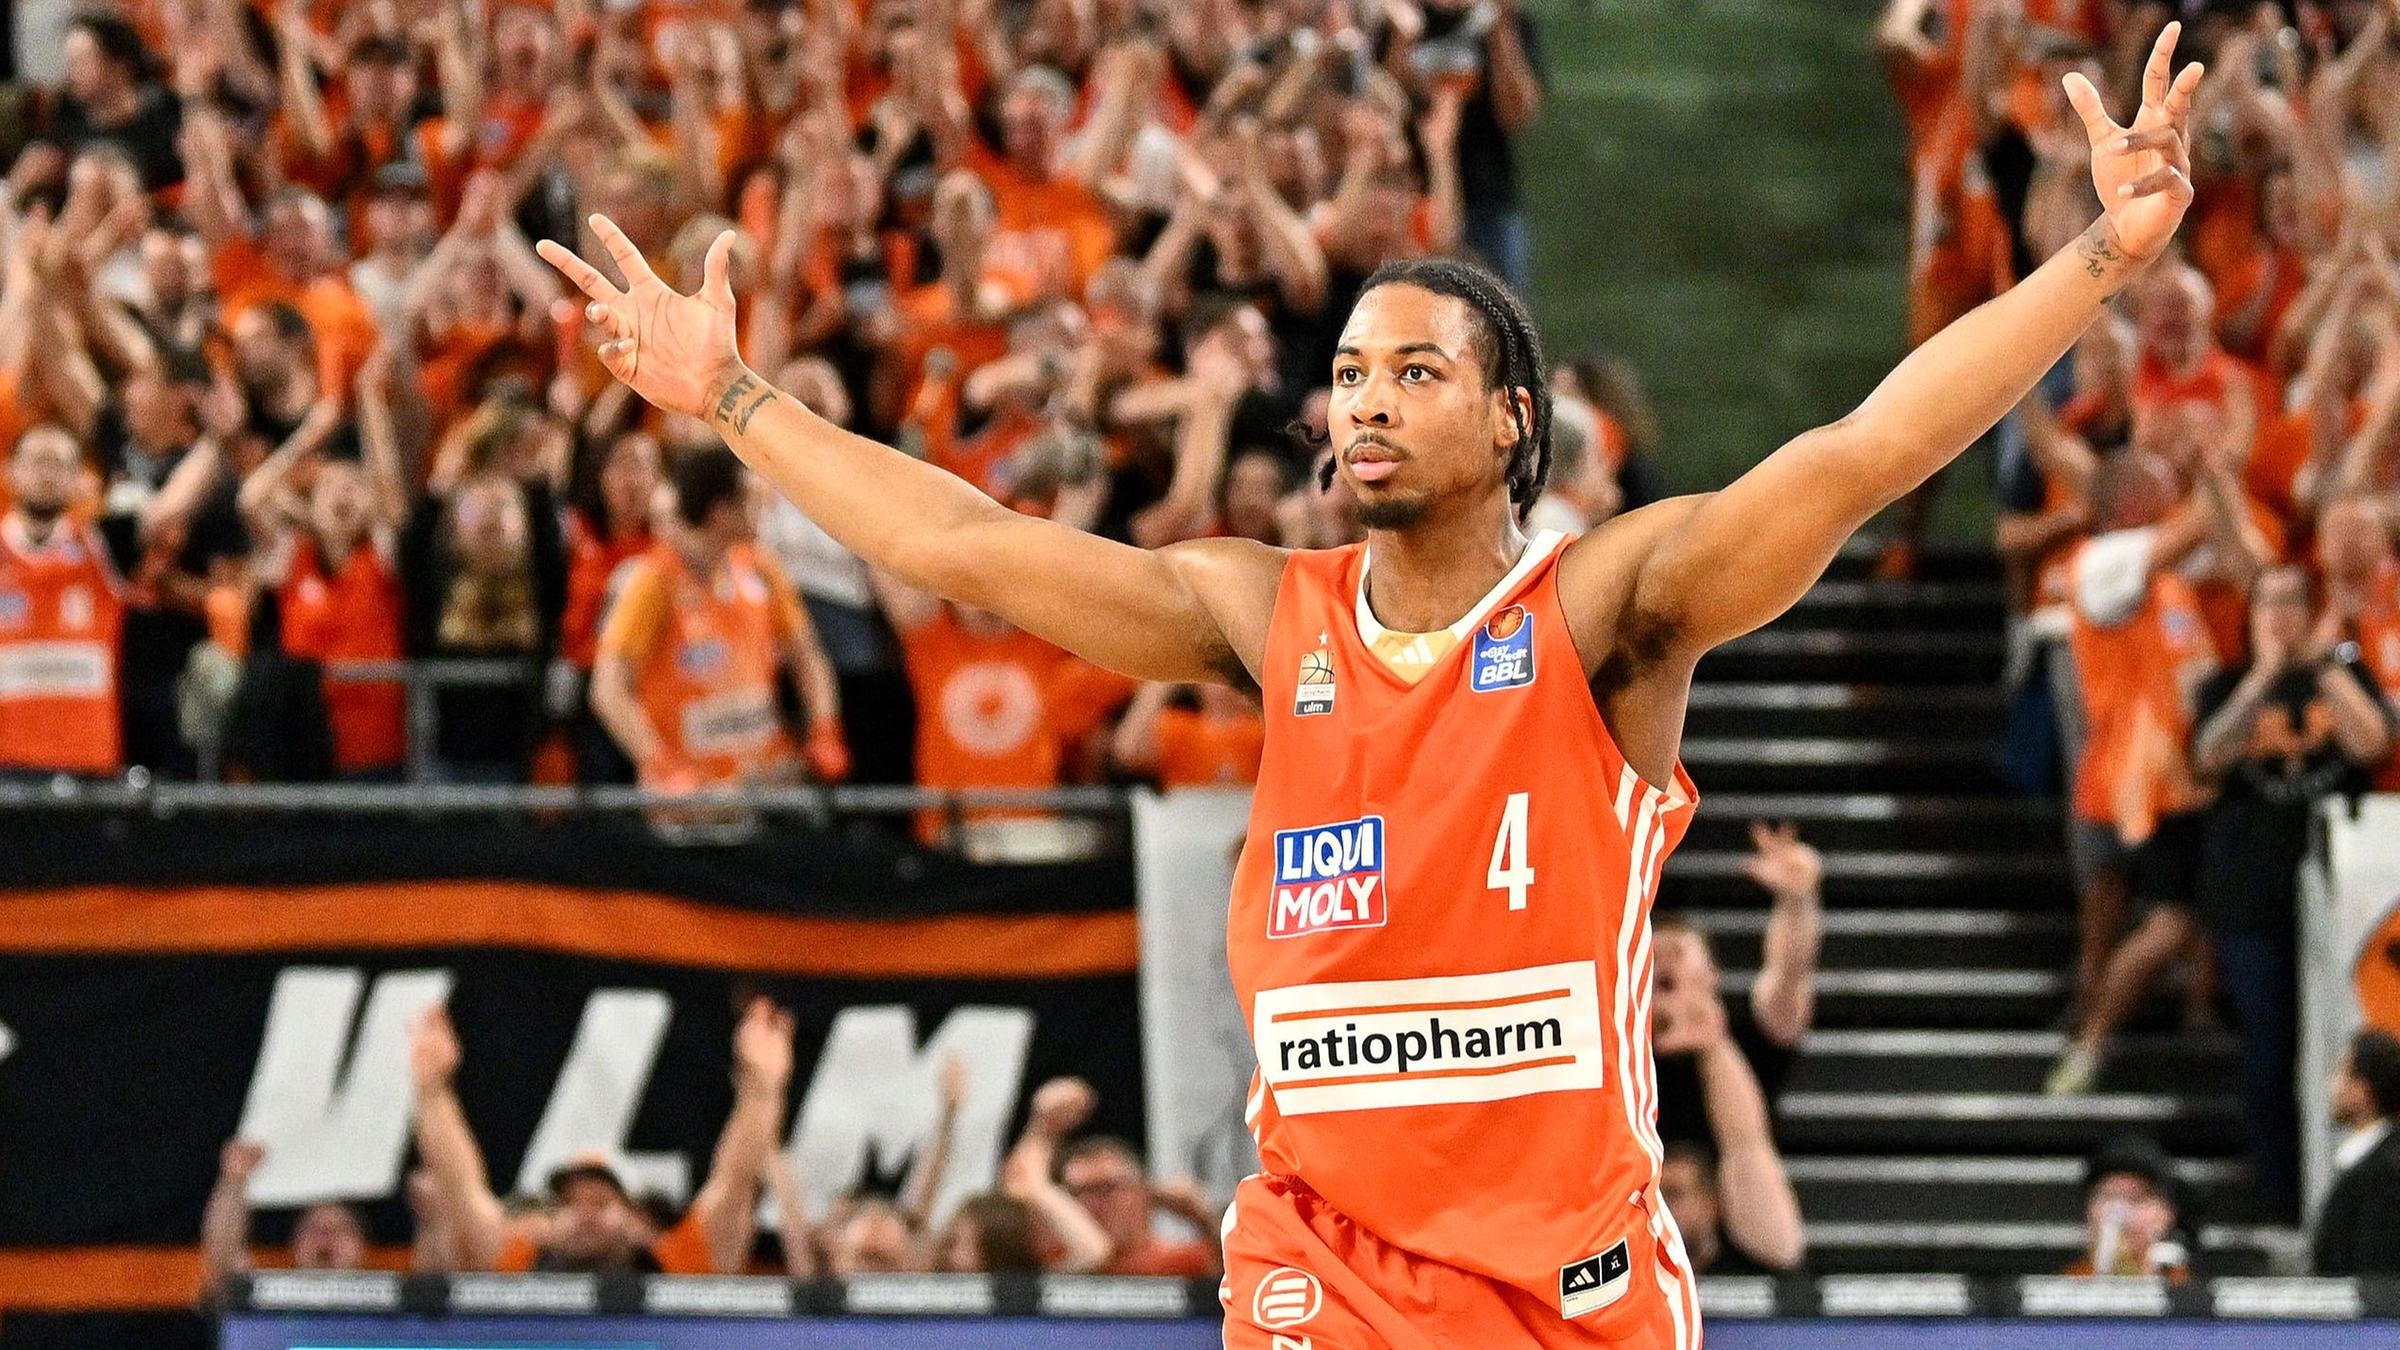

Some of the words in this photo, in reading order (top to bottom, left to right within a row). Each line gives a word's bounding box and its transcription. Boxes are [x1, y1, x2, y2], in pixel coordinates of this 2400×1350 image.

[1479, 660, 1528, 685] BBL
[1303, 701, 1324, 713] ulm
[1282, 822, 1374, 880] LIQUI
[1486, 791, 1535, 911] 4
[1275, 875, 1380, 931] MOLY
[1279, 1017, 1562, 1072] ratiopharm
